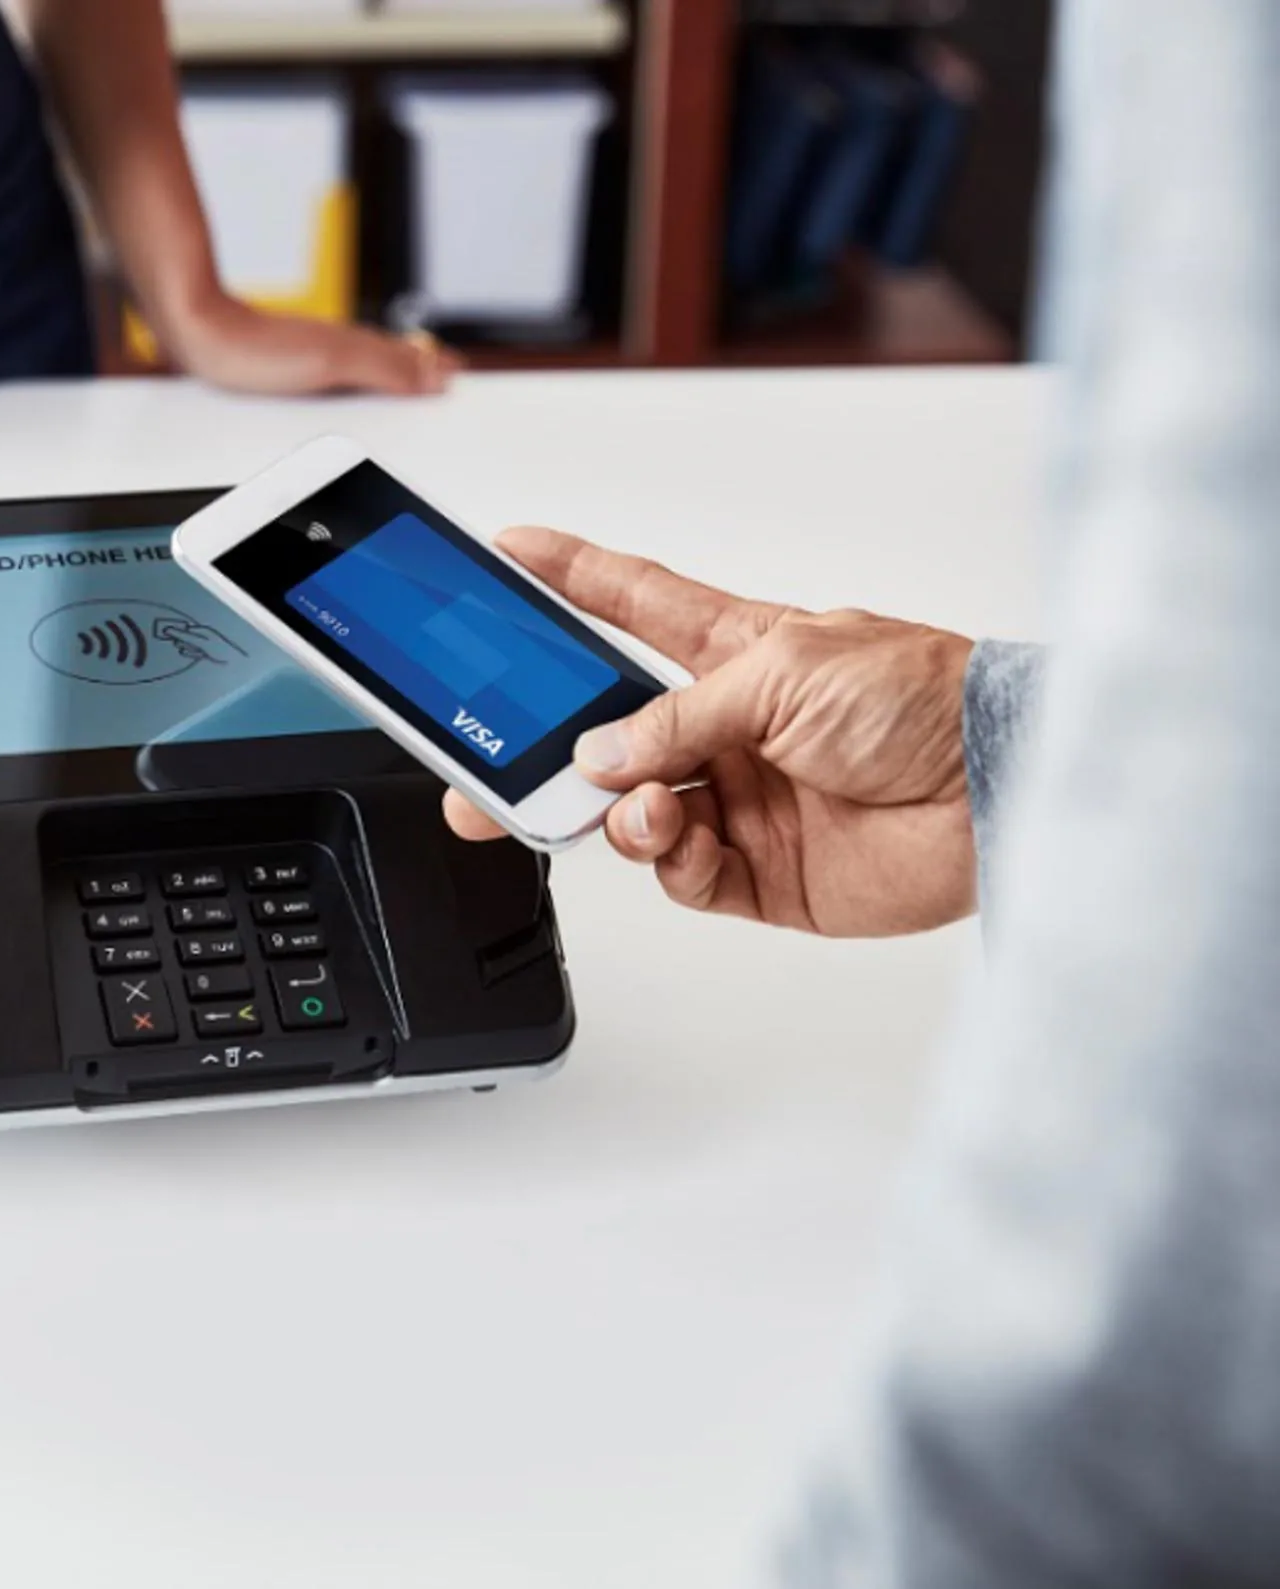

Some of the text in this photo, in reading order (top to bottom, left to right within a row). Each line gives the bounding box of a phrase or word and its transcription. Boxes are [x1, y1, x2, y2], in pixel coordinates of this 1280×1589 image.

[452, 706, 505, 757] VISA
[172, 873, 184, 887] 2
[254, 866, 266, 881] 3
[90, 881, 100, 893] 1
[182, 908, 193, 921] 5
[263, 901, 275, 915] 6
[97, 914, 109, 926] 4
[271, 933, 284, 948] 9
[104, 947, 116, 961] 7
[189, 942, 202, 955] 8
